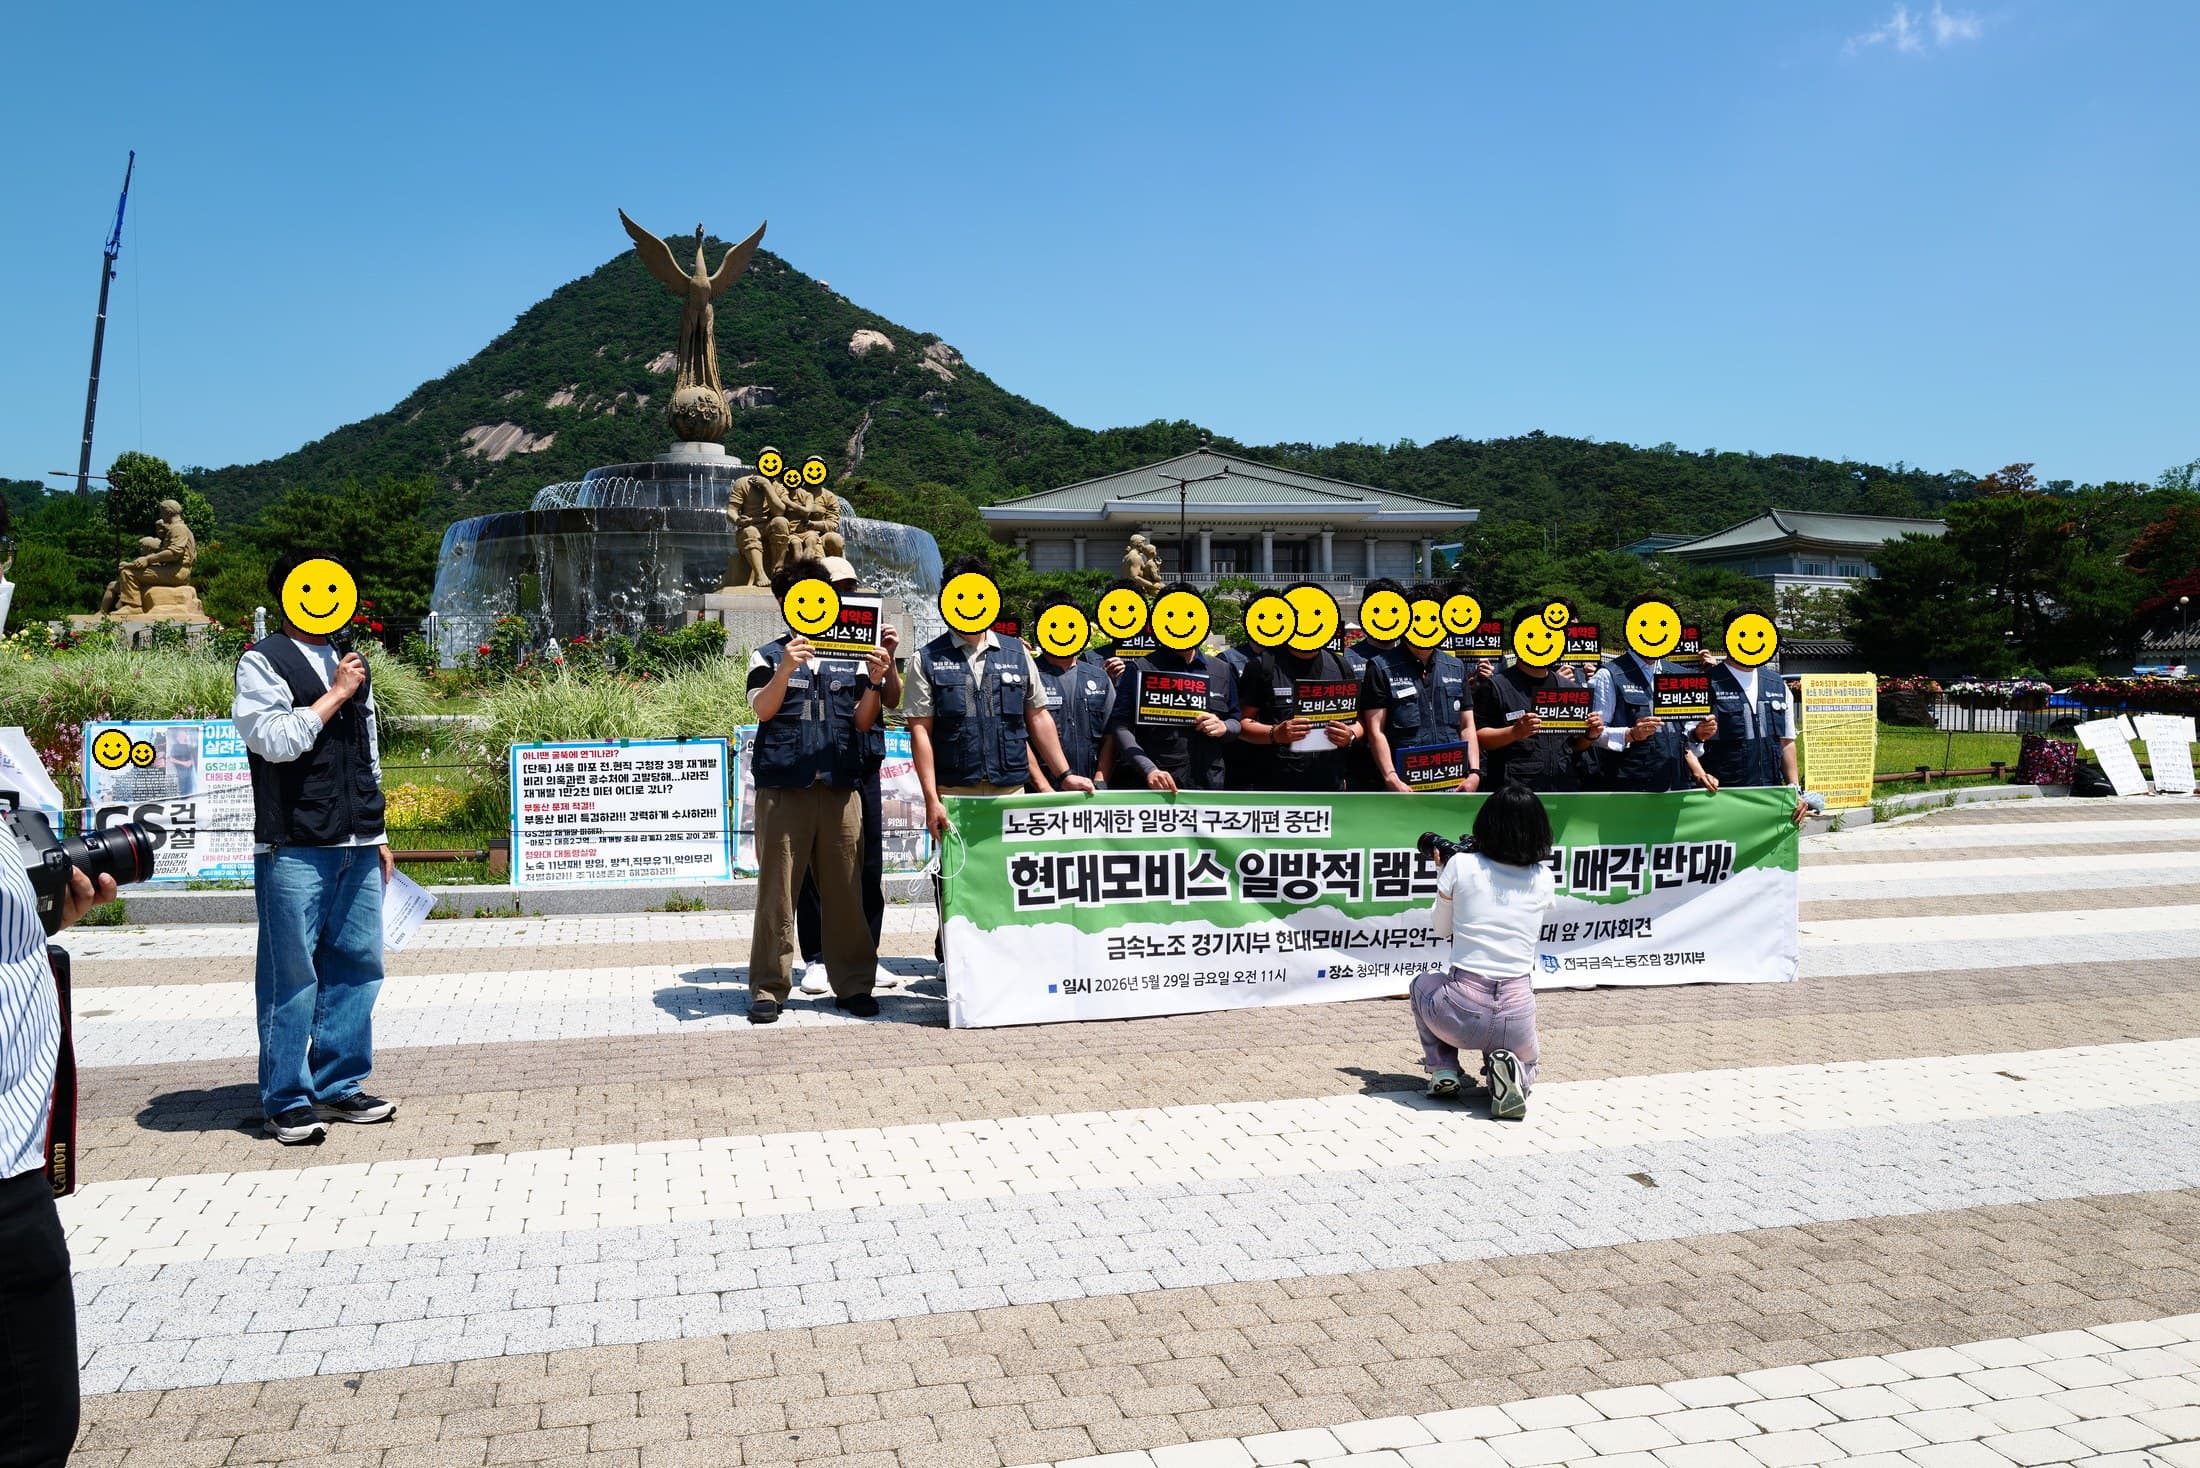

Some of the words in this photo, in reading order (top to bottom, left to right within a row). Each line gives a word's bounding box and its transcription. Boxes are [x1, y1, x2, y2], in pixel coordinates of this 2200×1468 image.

[817, 625, 872, 642] 비스'와!
[1567, 626, 1597, 638] 계약은
[1145, 675, 1207, 694] 근로계약은
[1298, 683, 1358, 698] 근로계약은
[1658, 677, 1709, 690] 근로계약은
[1535, 691, 1589, 704] 근로계약은
[555, 763, 575, 773] 서울
[578, 762, 597, 772] 마포
[635, 760, 664, 770] 구청장
[667, 760, 684, 769] 3명
[686, 759, 717, 768] 재개발
[1407, 750, 1464, 768] 근로계약은
[523, 776, 543, 786] 비리
[589, 773, 629, 784] 공수처에
[523, 788, 556, 798] 재개발
[558, 786, 590, 797] 1만2천
[593, 786, 613, 796] 미터
[615, 785, 644, 795] 어디로
[524, 803, 549, 812] 부동산
[552, 802, 570, 811] 문제
[524, 814, 554, 825] 부동산
[557, 813, 577, 823] 비리
[580, 812, 626, 822] 특검하라!!
[629, 810, 669, 821] 강력하게
[672, 808, 717, 819] 수사하라!!
[1005, 809, 1068, 835] 노동자
[1072, 807, 1134, 832] 배제한
[1139, 808, 1198, 832] 일방적
[1201, 808, 1280, 832] 구조개편
[1284, 808, 1330, 832] 중단!
[524, 861, 545, 870] 노숙
[1011, 852, 1228, 906] 현대모비스
[1239, 851, 1361, 900] 일방적
[1573, 846, 1644, 892] 매각
[1653, 843, 1733, 889] 반대!
[1107, 935, 1186, 960] 금속노조
[1192, 931, 1271, 956] 경기지부
[1276, 927, 1454, 952] 현대모비스사무연구
[1562, 922, 1579, 942] 앞
[1583, 917, 1653, 941] 기자회견
[1563, 953, 1662, 972] 전국금속노동조합
[1664, 951, 1706, 967] 경기지부
[1062, 978, 1092, 995] 일시
[1095, 976, 1139, 994] 2026년
[1141, 974, 1160, 991] 5월
[1164, 973, 1190, 990] 29일
[1193, 971, 1231, 988] 금요일
[1233, 969, 1257, 986] 오전
[1260, 967, 1287, 984] 11시
[1329, 964, 1353, 979] 장소
[1356, 963, 1390, 979] 청와대
[1393, 961, 1428, 977] 사랑채
[52, 1143, 67, 1194] Canon
